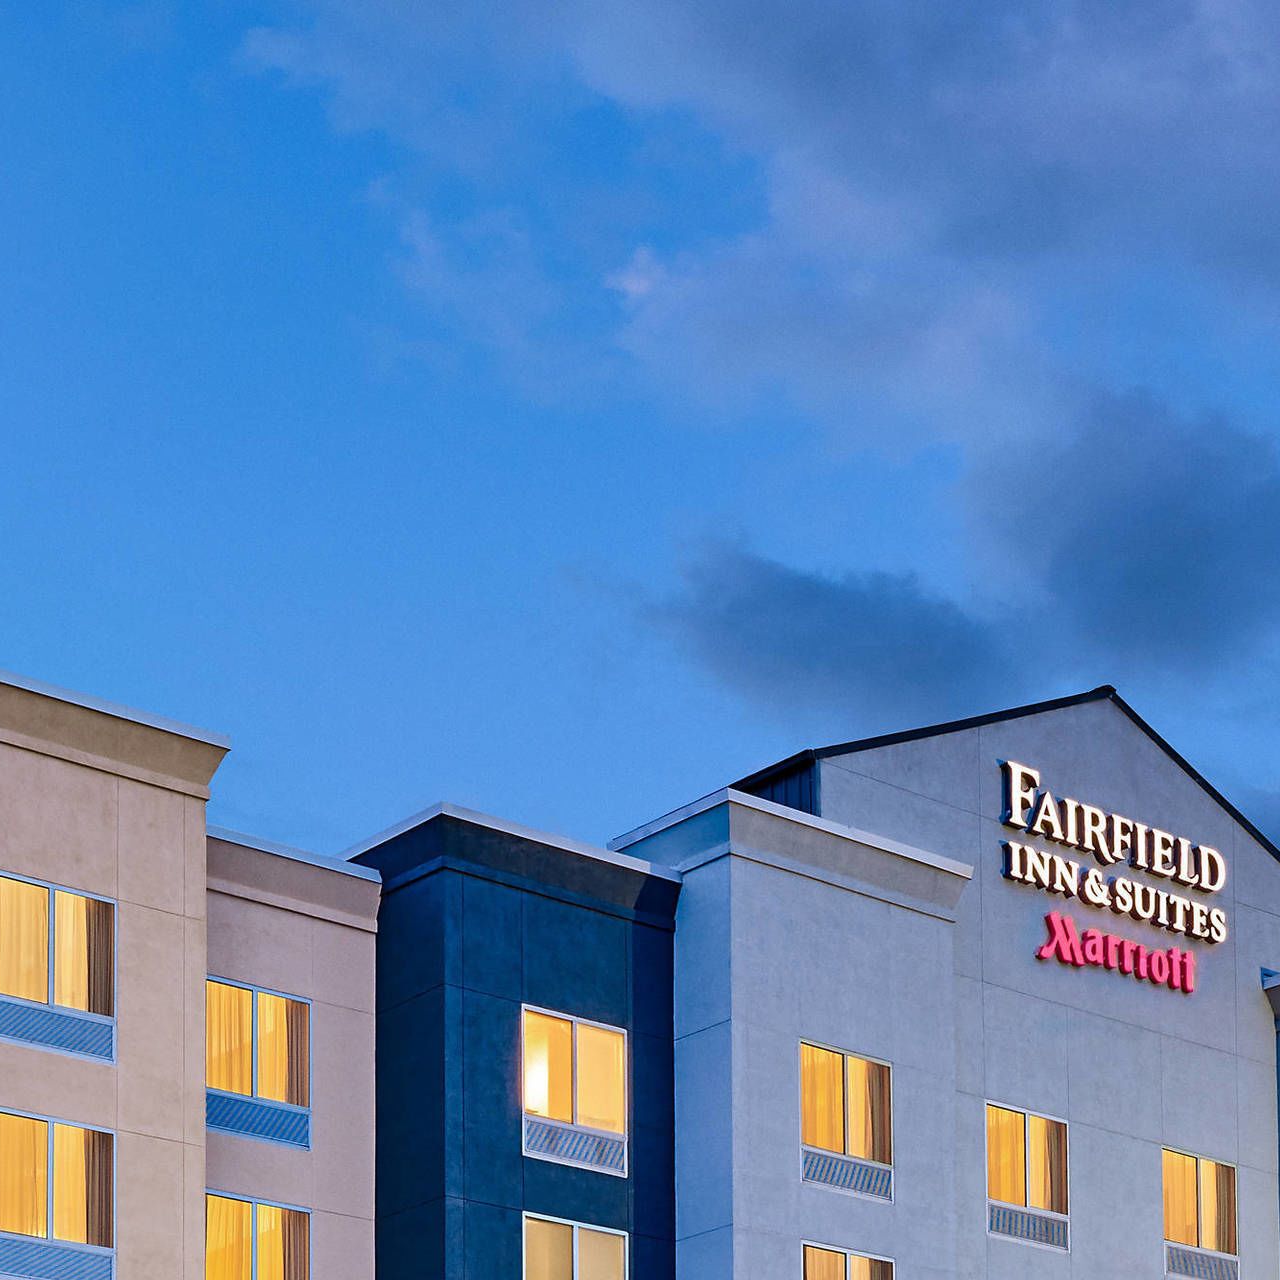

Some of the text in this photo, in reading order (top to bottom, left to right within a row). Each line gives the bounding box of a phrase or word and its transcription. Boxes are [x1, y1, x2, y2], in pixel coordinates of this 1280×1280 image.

[1002, 759, 1227, 893] FAIRFIELD
[1003, 841, 1228, 944] INN & SUITES
[1036, 911, 1195, 993] Marriott
